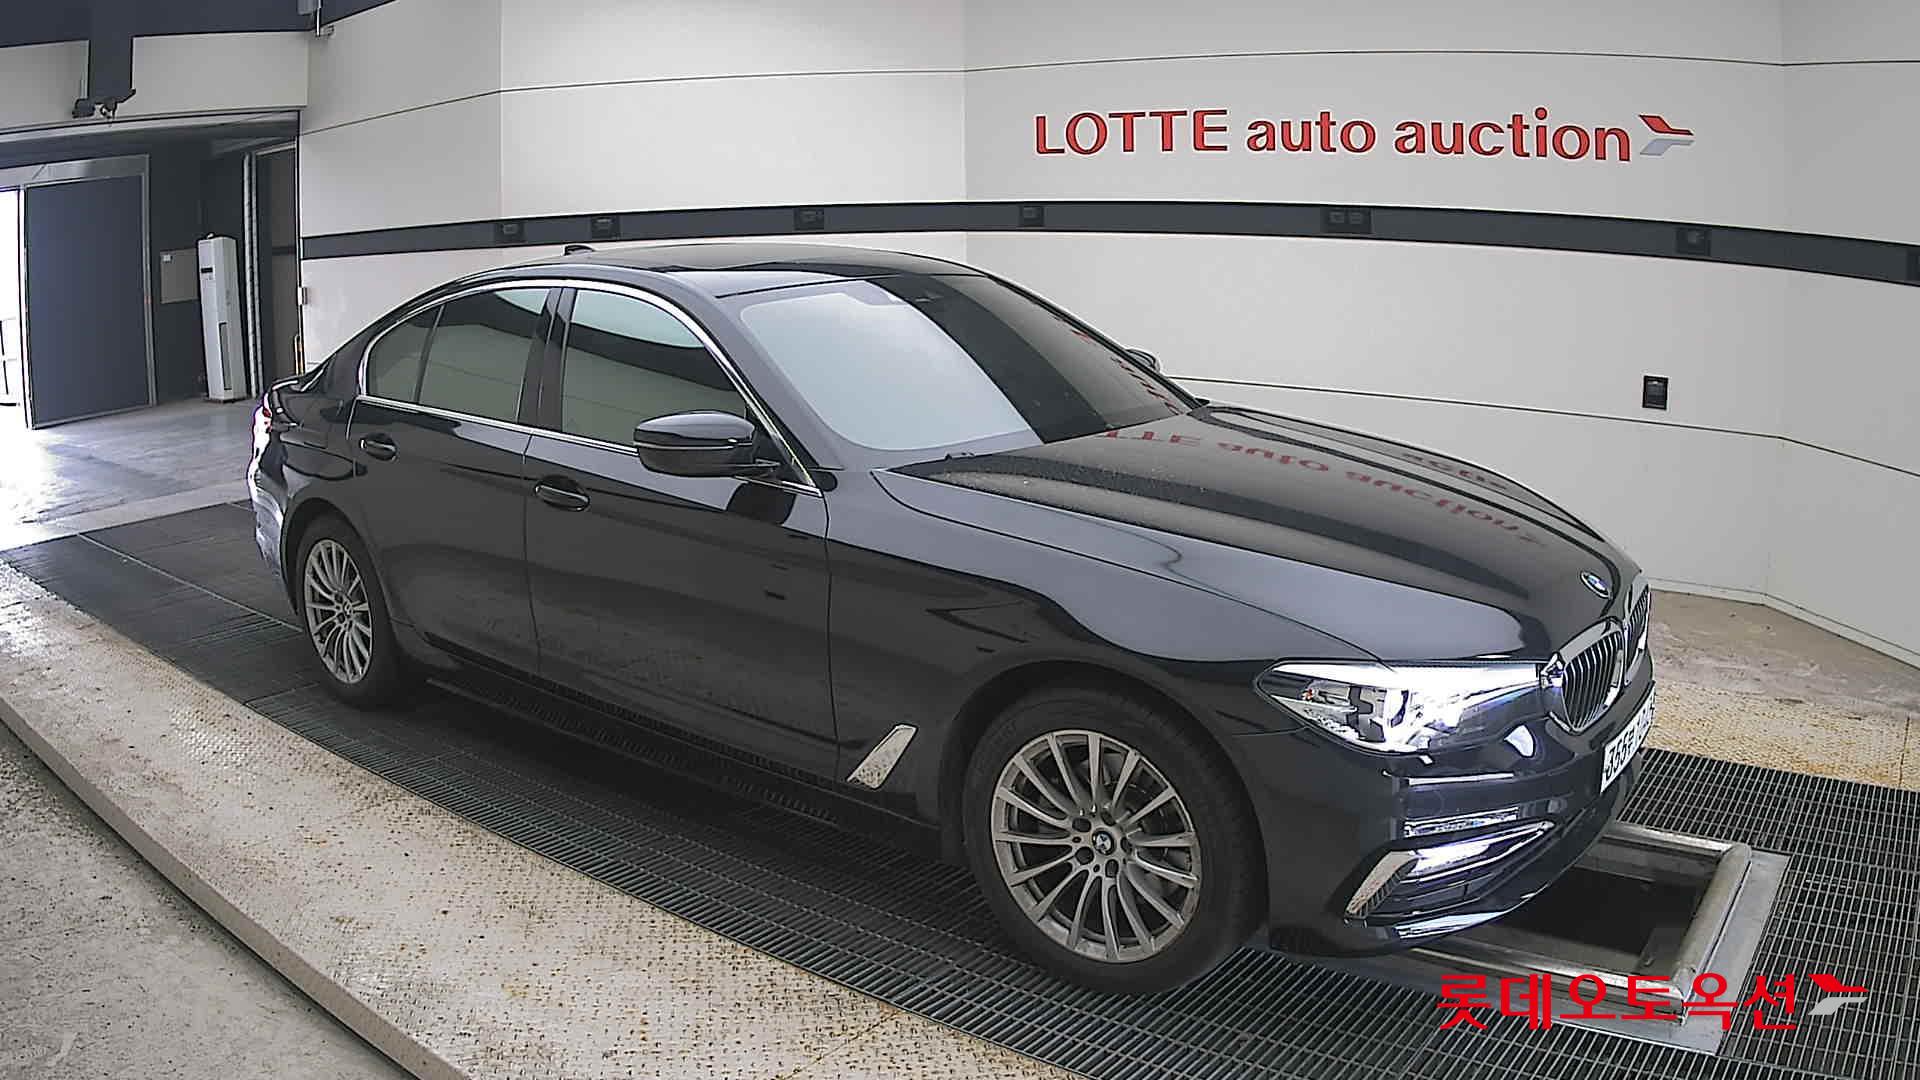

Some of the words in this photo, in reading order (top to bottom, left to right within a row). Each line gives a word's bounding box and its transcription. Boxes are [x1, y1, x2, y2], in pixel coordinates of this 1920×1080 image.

[1036, 110, 1228, 155] LOTTE
[1247, 111, 1376, 154] auto
[1394, 107, 1631, 162] auction
